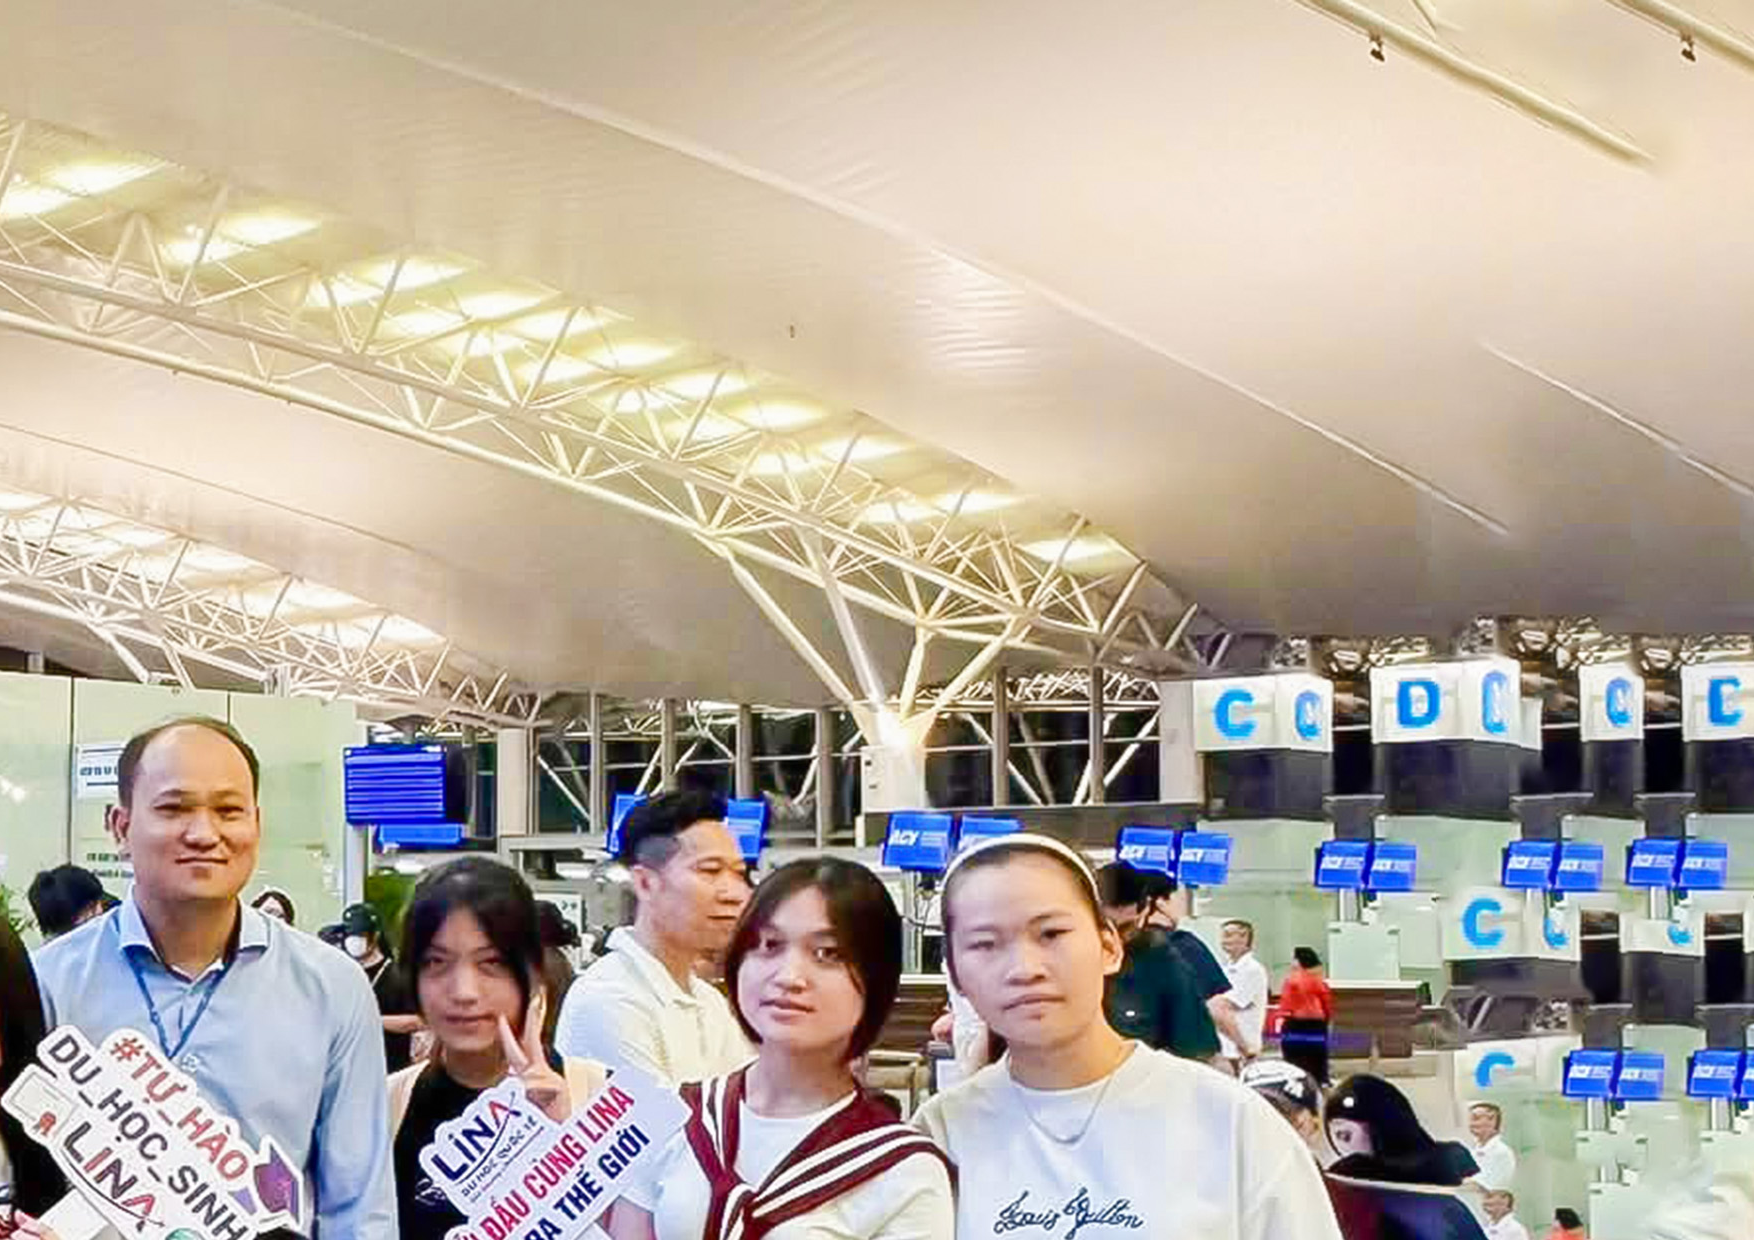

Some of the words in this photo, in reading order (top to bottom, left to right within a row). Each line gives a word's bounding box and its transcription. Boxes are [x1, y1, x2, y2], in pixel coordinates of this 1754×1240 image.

[1213, 688, 1258, 739] C
[1398, 680, 1441, 728] D
[1462, 897, 1502, 949] C
[575, 1086, 636, 1144] LINA
